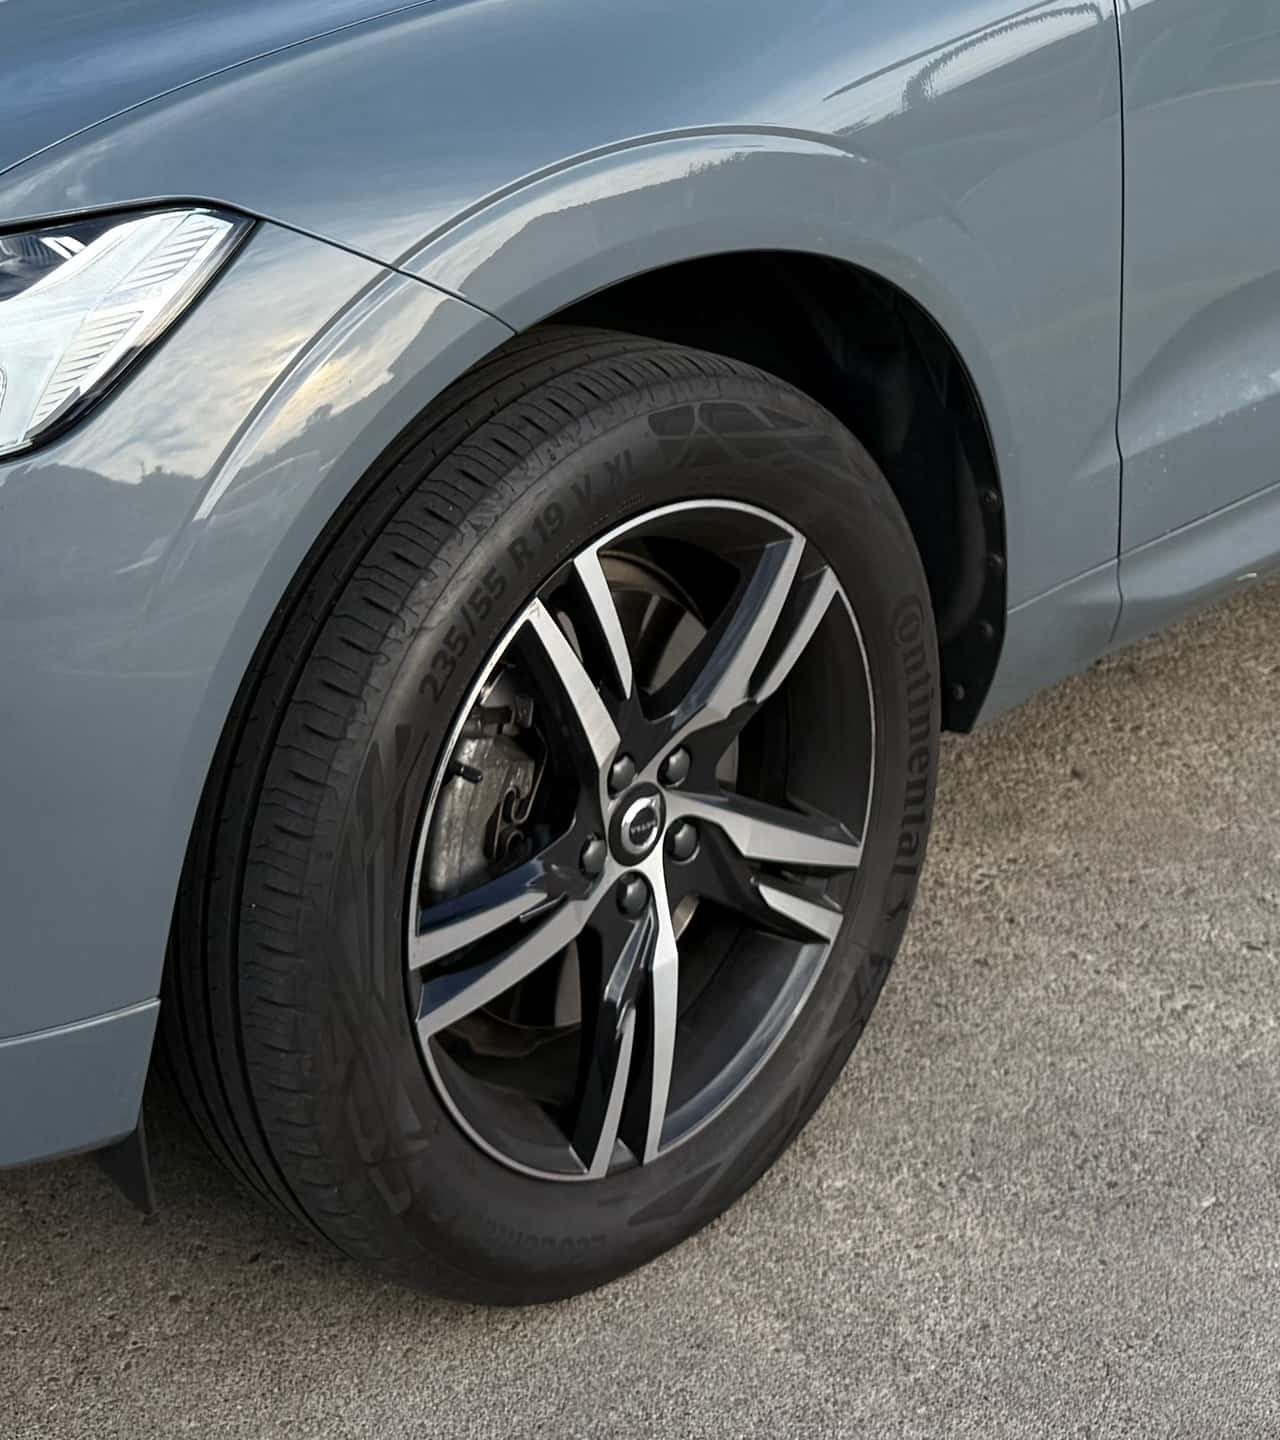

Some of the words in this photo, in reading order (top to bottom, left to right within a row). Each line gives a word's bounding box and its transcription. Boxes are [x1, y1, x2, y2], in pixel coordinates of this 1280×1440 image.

[419, 567, 508, 703] 235/55
[532, 502, 566, 545] 19
[889, 593, 932, 876] Continental
